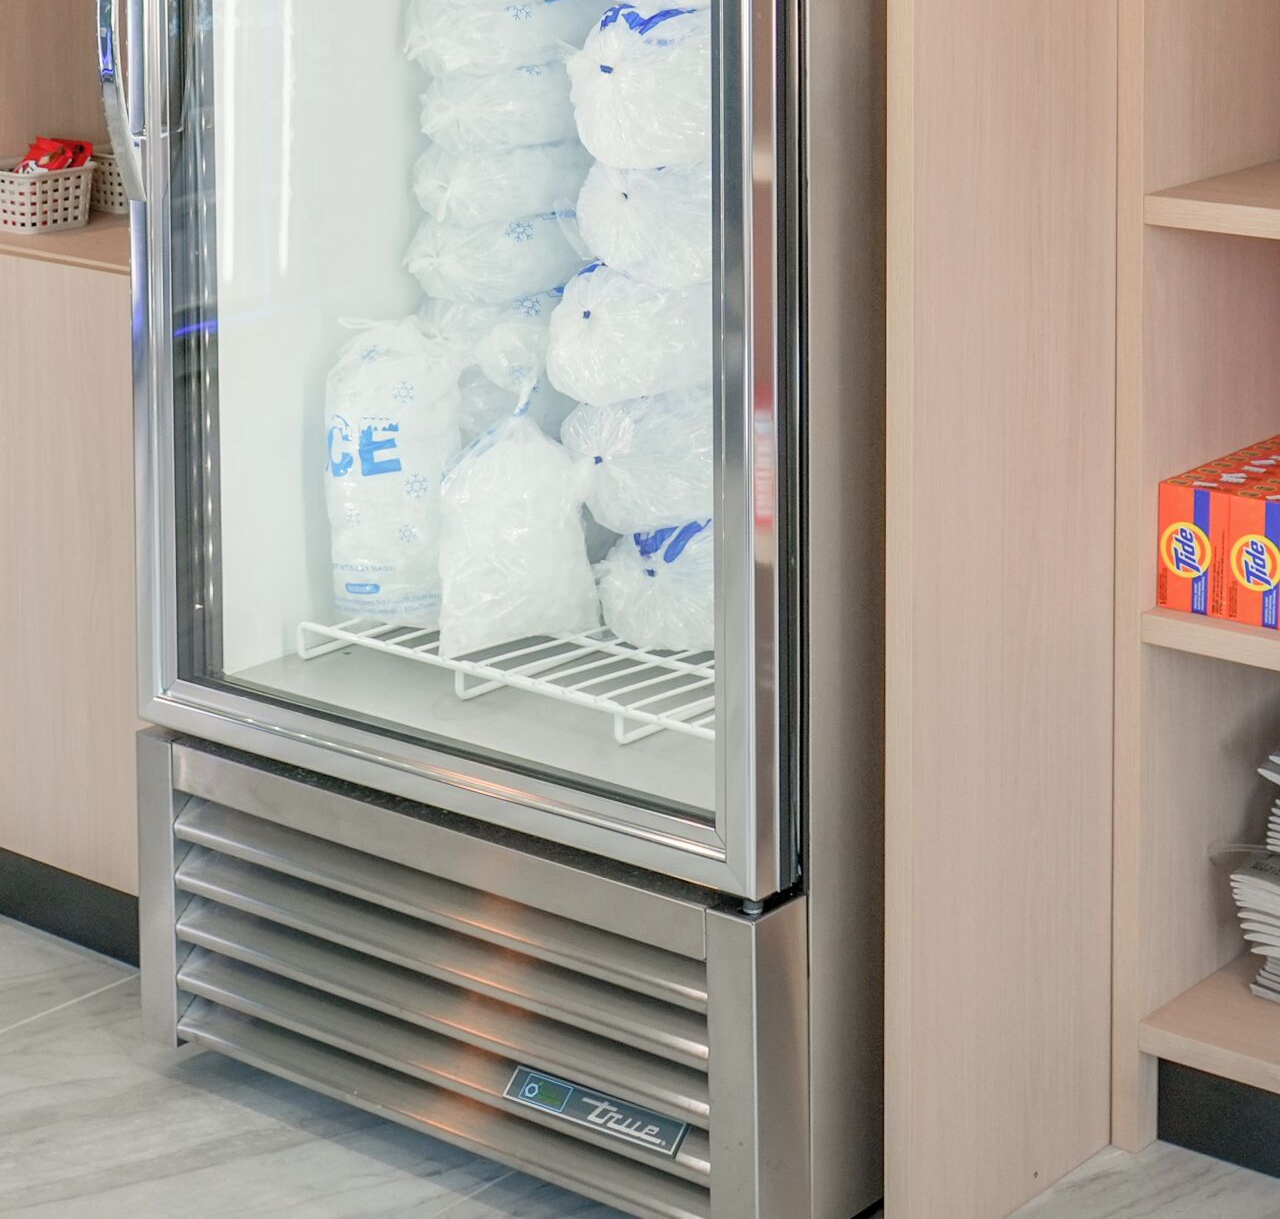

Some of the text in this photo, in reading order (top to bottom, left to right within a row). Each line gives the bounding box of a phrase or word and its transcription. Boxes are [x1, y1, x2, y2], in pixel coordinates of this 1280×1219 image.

[327, 415, 402, 478] CE
[1173, 527, 1202, 574] Tide
[1244, 540, 1273, 588] Tide
[582, 1096, 662, 1145] true
